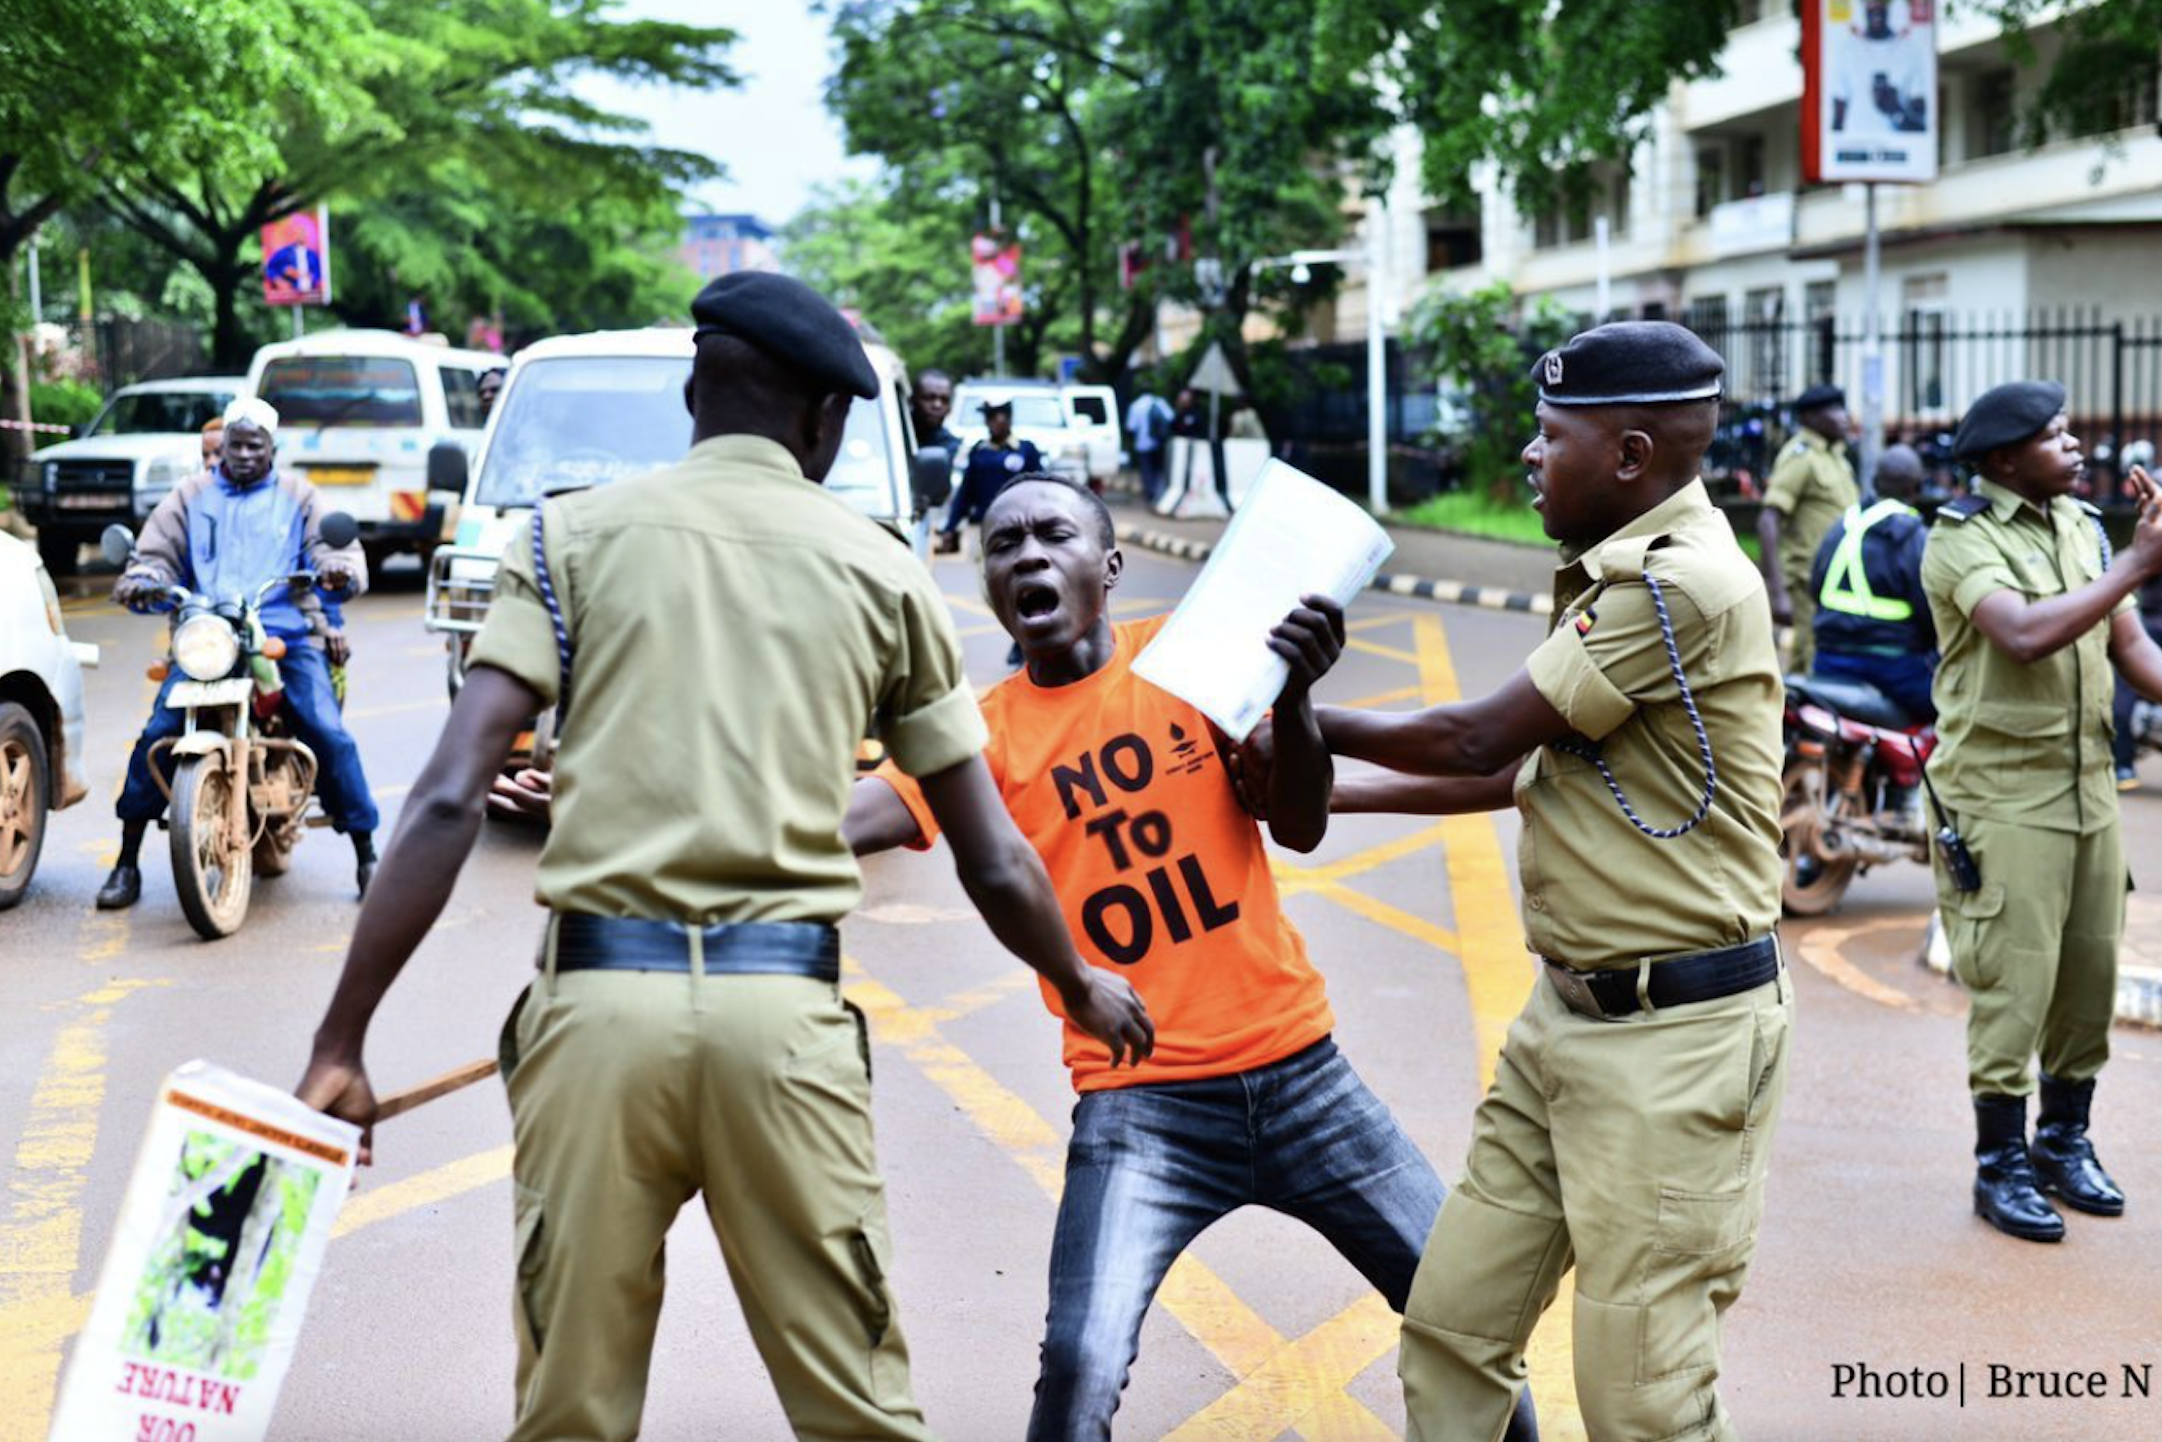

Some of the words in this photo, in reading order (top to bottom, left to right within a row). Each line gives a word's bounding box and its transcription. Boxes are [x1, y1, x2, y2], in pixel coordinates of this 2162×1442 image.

[1051, 733, 1153, 820] NO
[1082, 853, 1240, 965] OIL
[117, 1363, 241, 1414] NATURE
